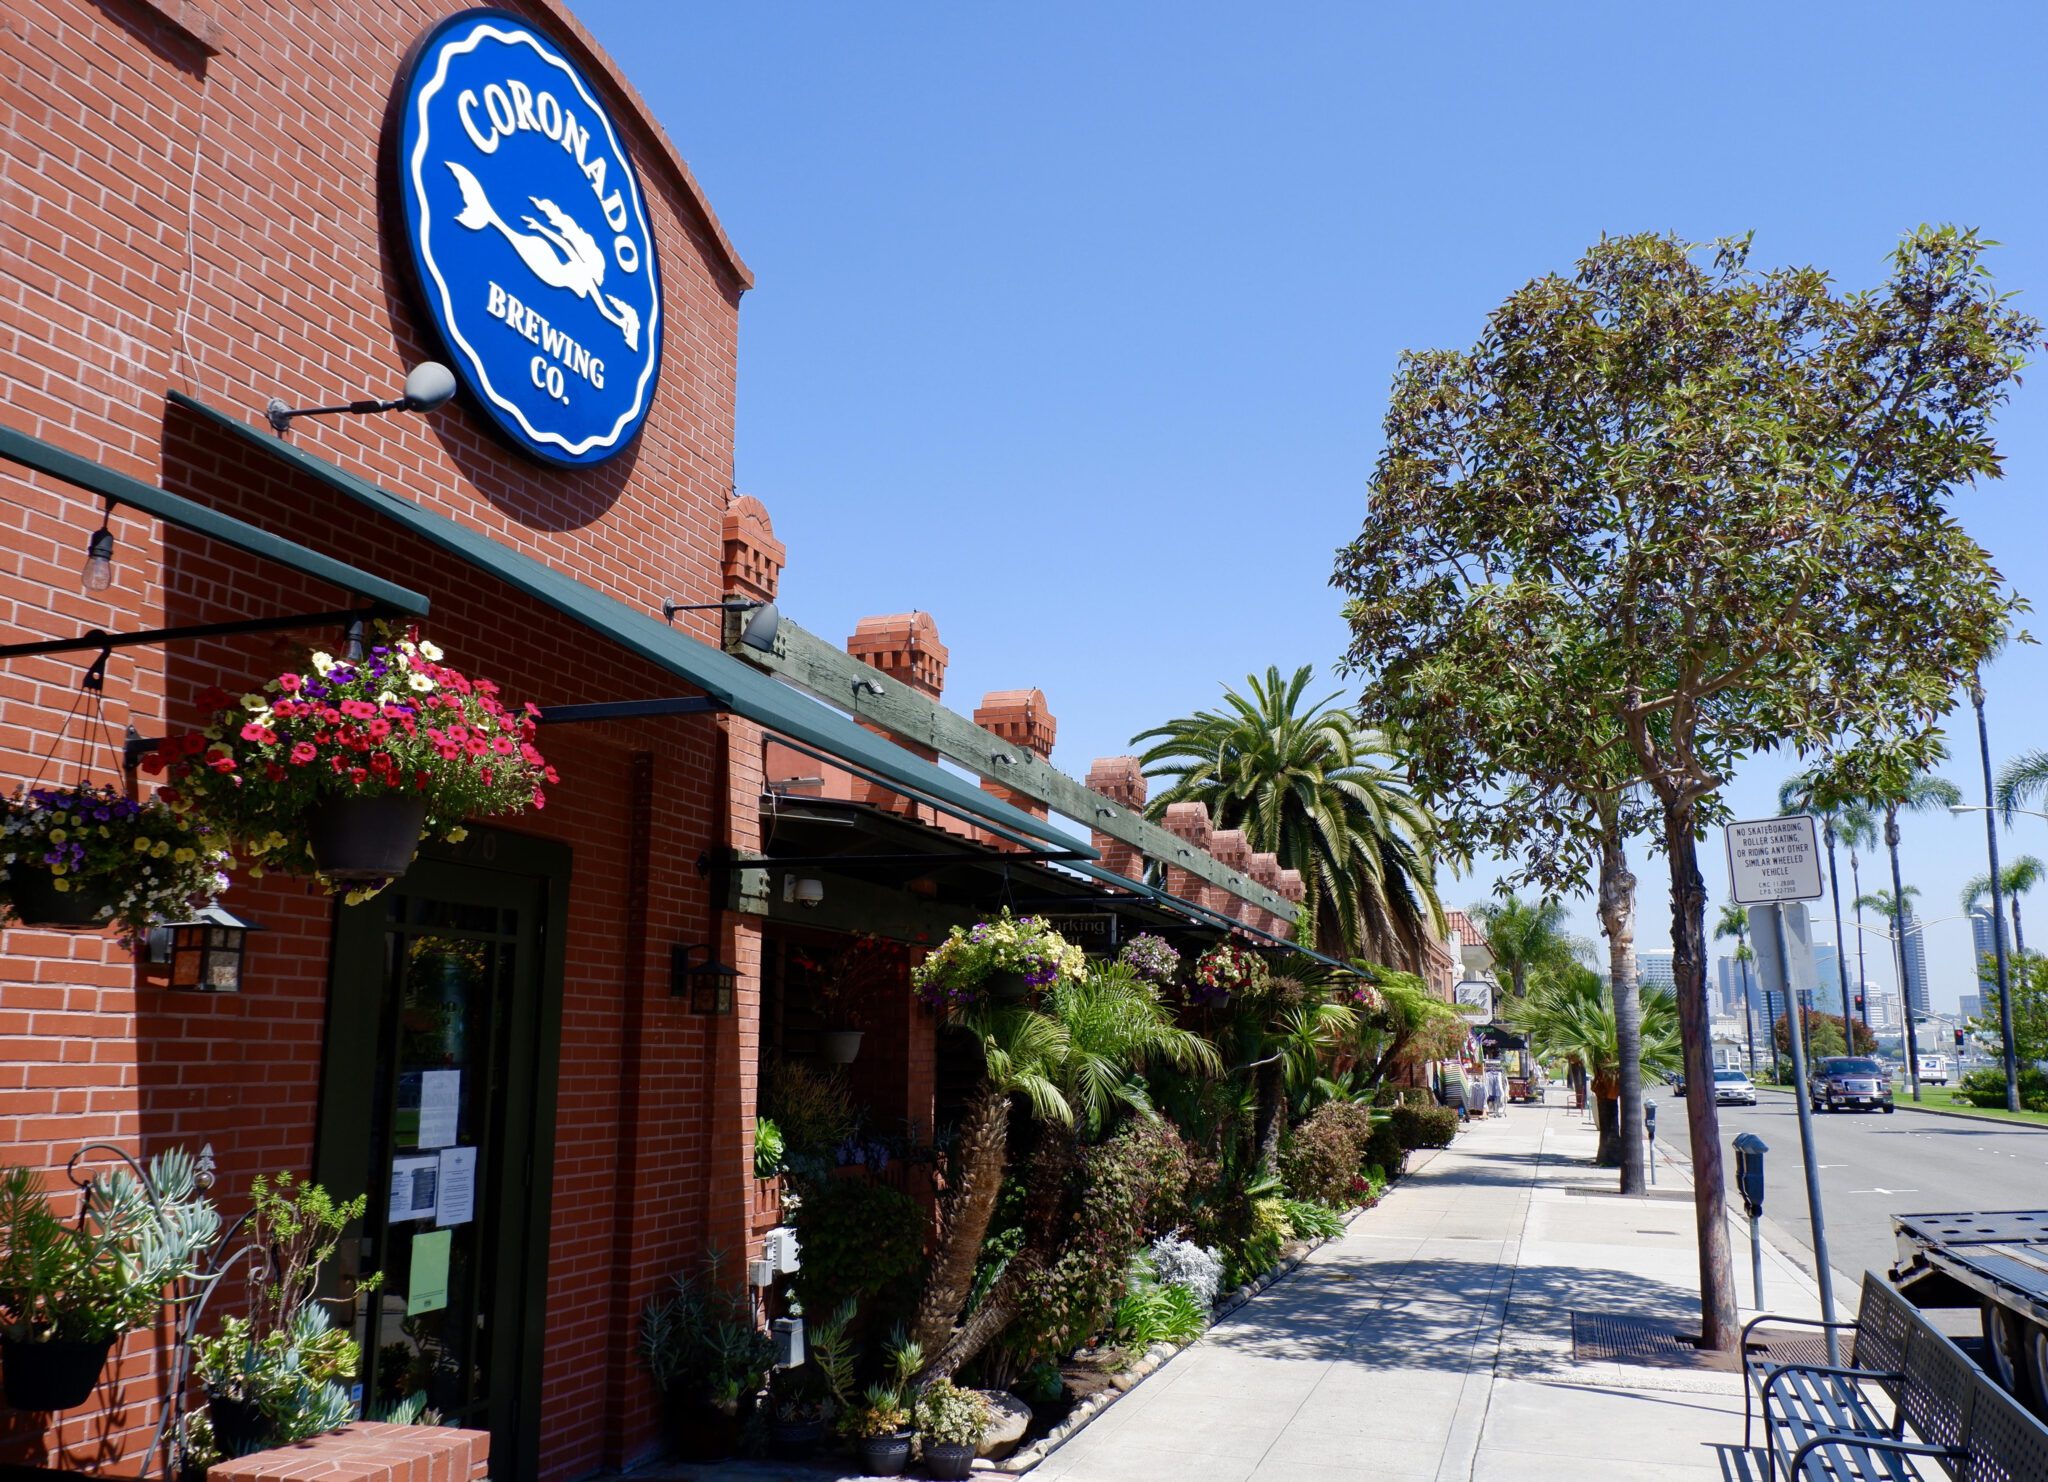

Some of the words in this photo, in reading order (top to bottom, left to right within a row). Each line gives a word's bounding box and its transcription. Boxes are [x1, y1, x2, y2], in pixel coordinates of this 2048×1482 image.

[458, 78, 639, 273] CORONADO
[486, 281, 605, 389] BREWING
[530, 355, 570, 405] CO.
[1736, 828, 1746, 837] NO
[1748, 823, 1803, 836] SKATEBOARDING,
[1743, 836, 1768, 846] ROLLER
[1770, 833, 1800, 844] SKATING,
[1736, 848, 1746, 858] OR
[1748, 847, 1769, 857] RIDING
[1771, 845, 1785, 854] ANY
[1787, 843, 1809, 853] OTHER
[1744, 857, 1771, 868] SIMILAR
[1772, 854, 1803, 865] WHEELED
[1761, 866, 1789, 877] VEHICLE
[1052, 918, 1105, 935] arking
